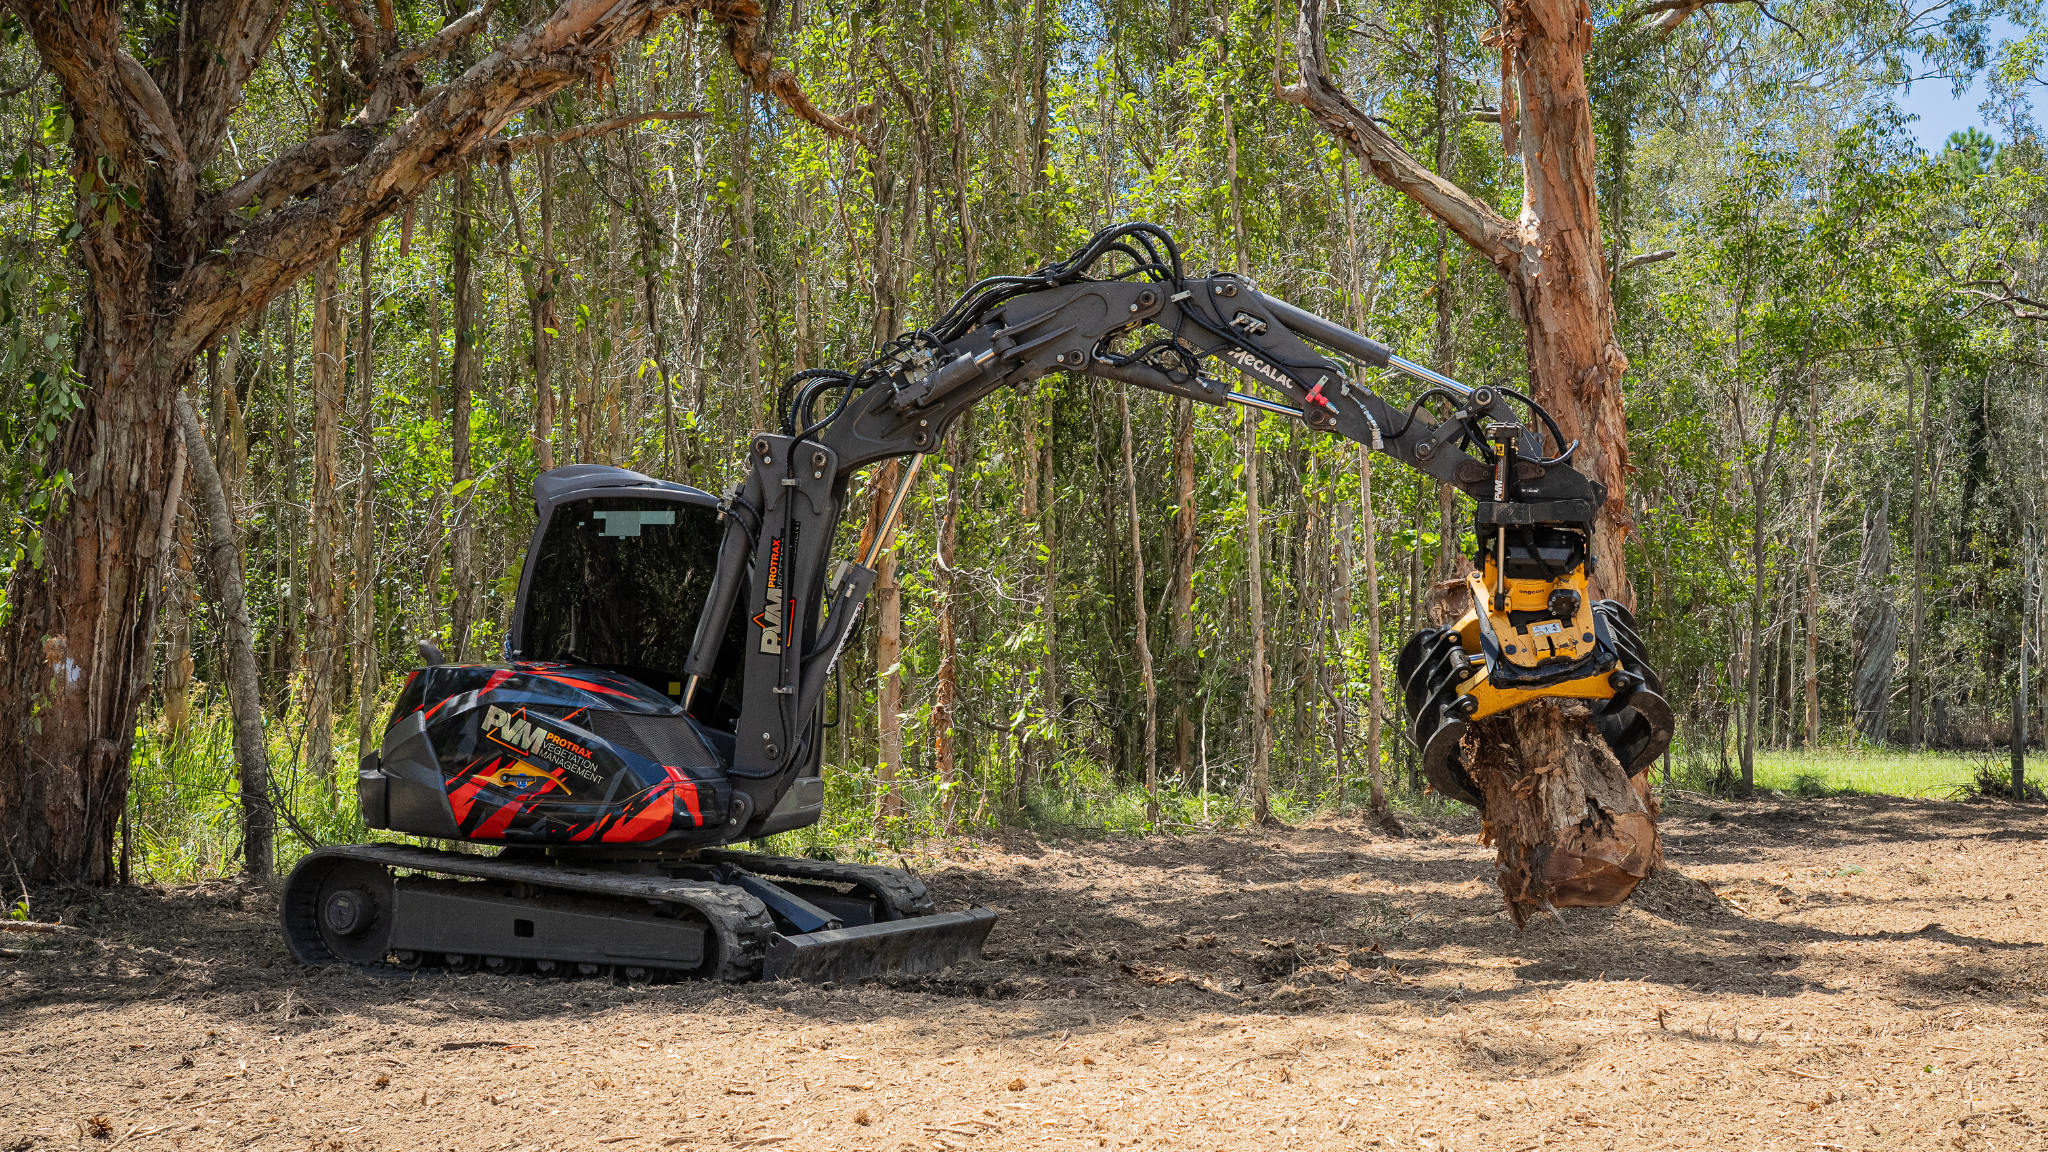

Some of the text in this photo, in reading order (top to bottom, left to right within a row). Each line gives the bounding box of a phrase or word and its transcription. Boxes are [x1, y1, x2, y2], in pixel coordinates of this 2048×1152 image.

[768, 539, 781, 588] PROTRAX
[760, 588, 783, 655] PVM
[481, 704, 548, 755] PVM
[546, 732, 593, 760] PROTRAX
[539, 749, 605, 785] MANAGEMENT
[543, 740, 599, 773] VEGETATION
